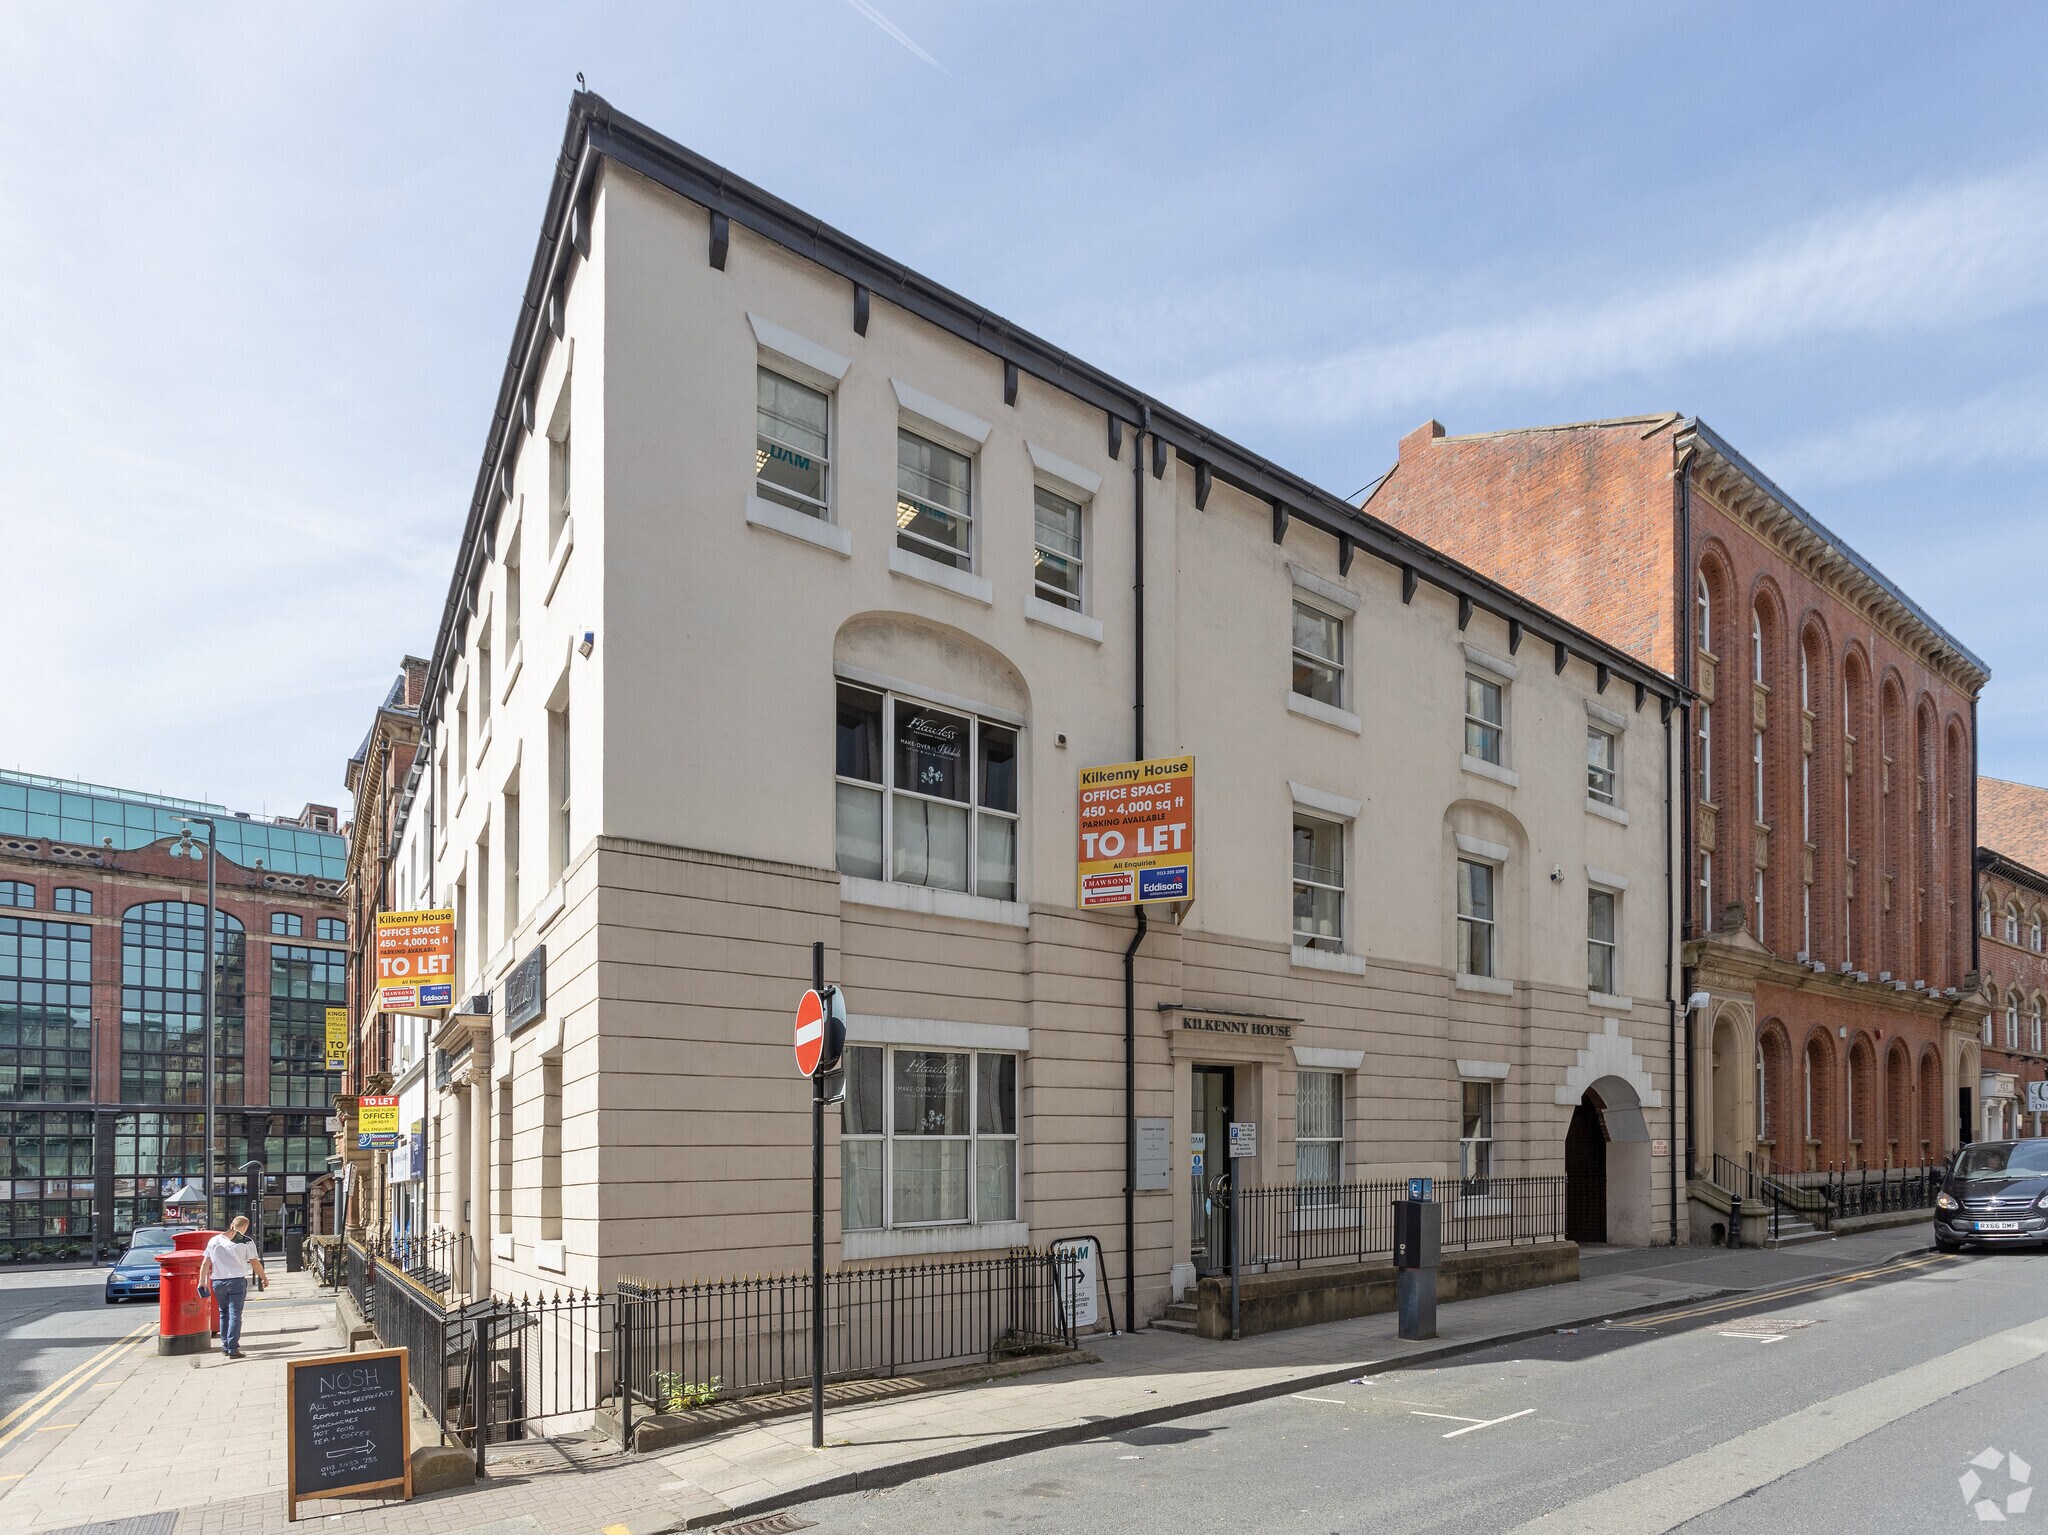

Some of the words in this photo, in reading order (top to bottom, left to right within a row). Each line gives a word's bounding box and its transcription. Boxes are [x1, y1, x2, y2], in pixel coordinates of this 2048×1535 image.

[906, 717, 958, 739] Flawless
[900, 739, 930, 750] MAKE-OVER
[1082, 768, 1140, 784] Kilkenny
[1144, 763, 1188, 776] House
[1083, 788, 1127, 803] OFFICE
[1130, 782, 1171, 798] SPACE
[1083, 806, 1105, 818] 450
[1116, 802, 1152, 816] 4,000
[1156, 800, 1171, 810] sq
[1175, 796, 1184, 807] ft
[1083, 818, 1120, 828] PARKING
[1122, 813, 1166, 825] AVAILABLE
[1082, 830, 1125, 859] TO
[1138, 823, 1186, 854] LET
[1124, 859, 1156, 868] Enquiries
[1088, 877, 1129, 887] MAWSONS
[1144, 883, 1183, 892] Eddisons
[380, 915, 418, 924] Kilkenny
[380, 928, 410, 937] OFFICE
[412, 926, 440, 935] SPACE
[403, 938, 427, 947] 4,000
[380, 957, 410, 976] TO
[418, 954, 450, 974] LET
[1184, 1018, 1249, 1034] KILKENNY
[1252, 1024, 1291, 1037] HOUSE
[905, 1058, 960, 1075] Flawless
[320, 1369, 379, 1392] NOSH
[309, 1403, 328, 1412] ALL
[313, 1412, 340, 1420] ROAST
[314, 1430, 329, 1438] HOT
[341, 1430, 370, 1439] COFFEE
